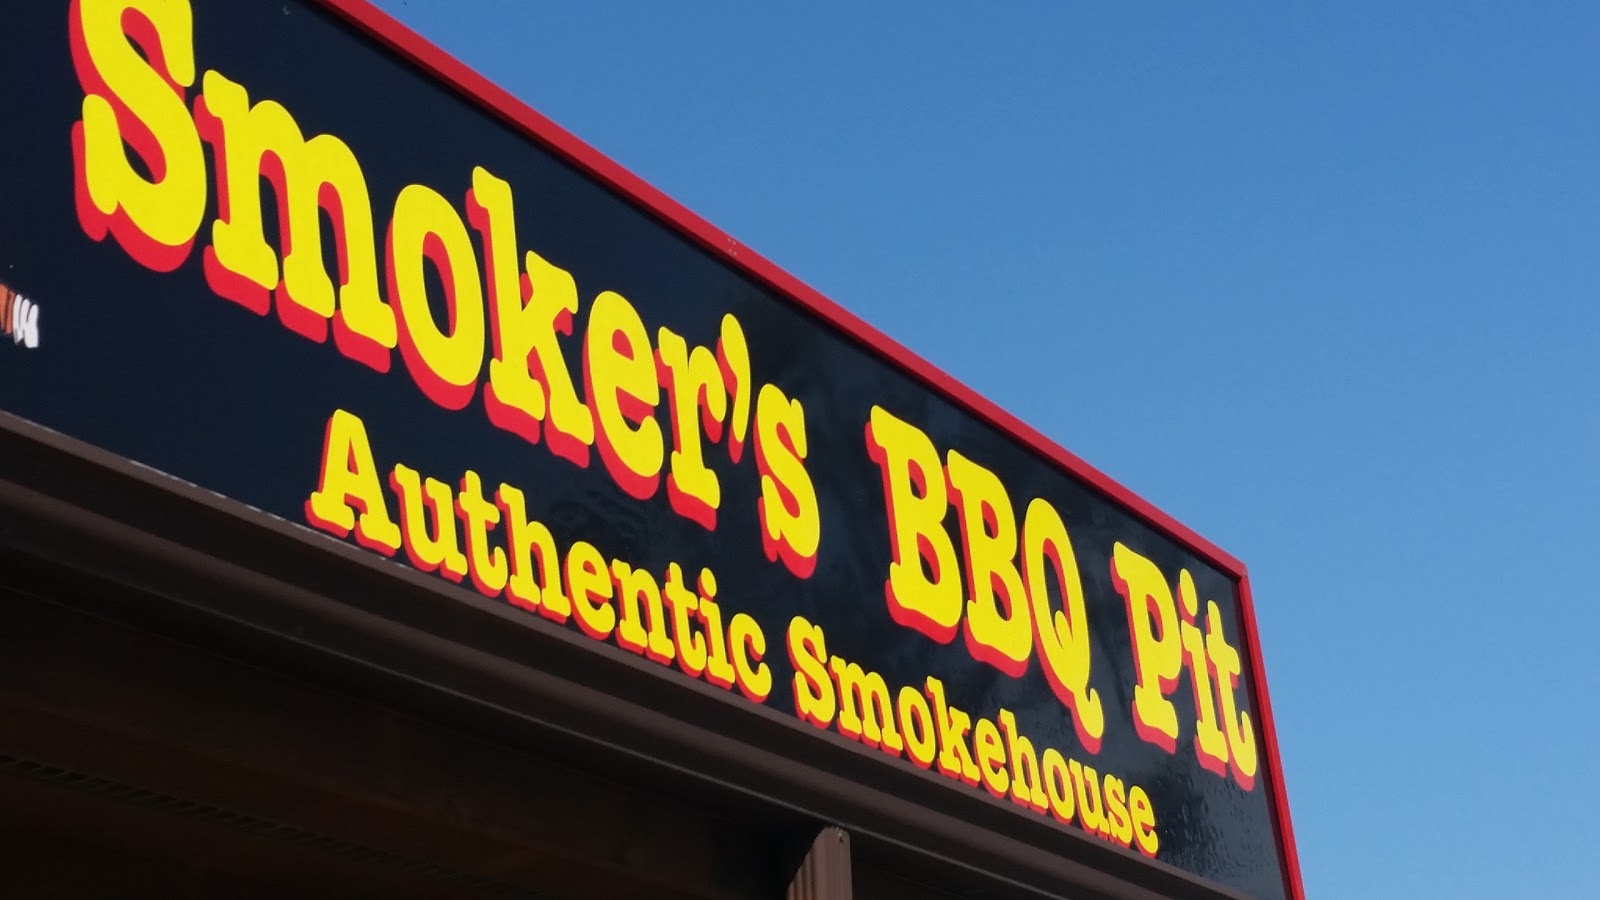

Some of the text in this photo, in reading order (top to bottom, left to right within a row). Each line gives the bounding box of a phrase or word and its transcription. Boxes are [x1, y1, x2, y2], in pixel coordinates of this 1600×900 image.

[70, 0, 1258, 792] Smoker's BBQ Pit
[305, 408, 1160, 858] Authentic Smokehouse
